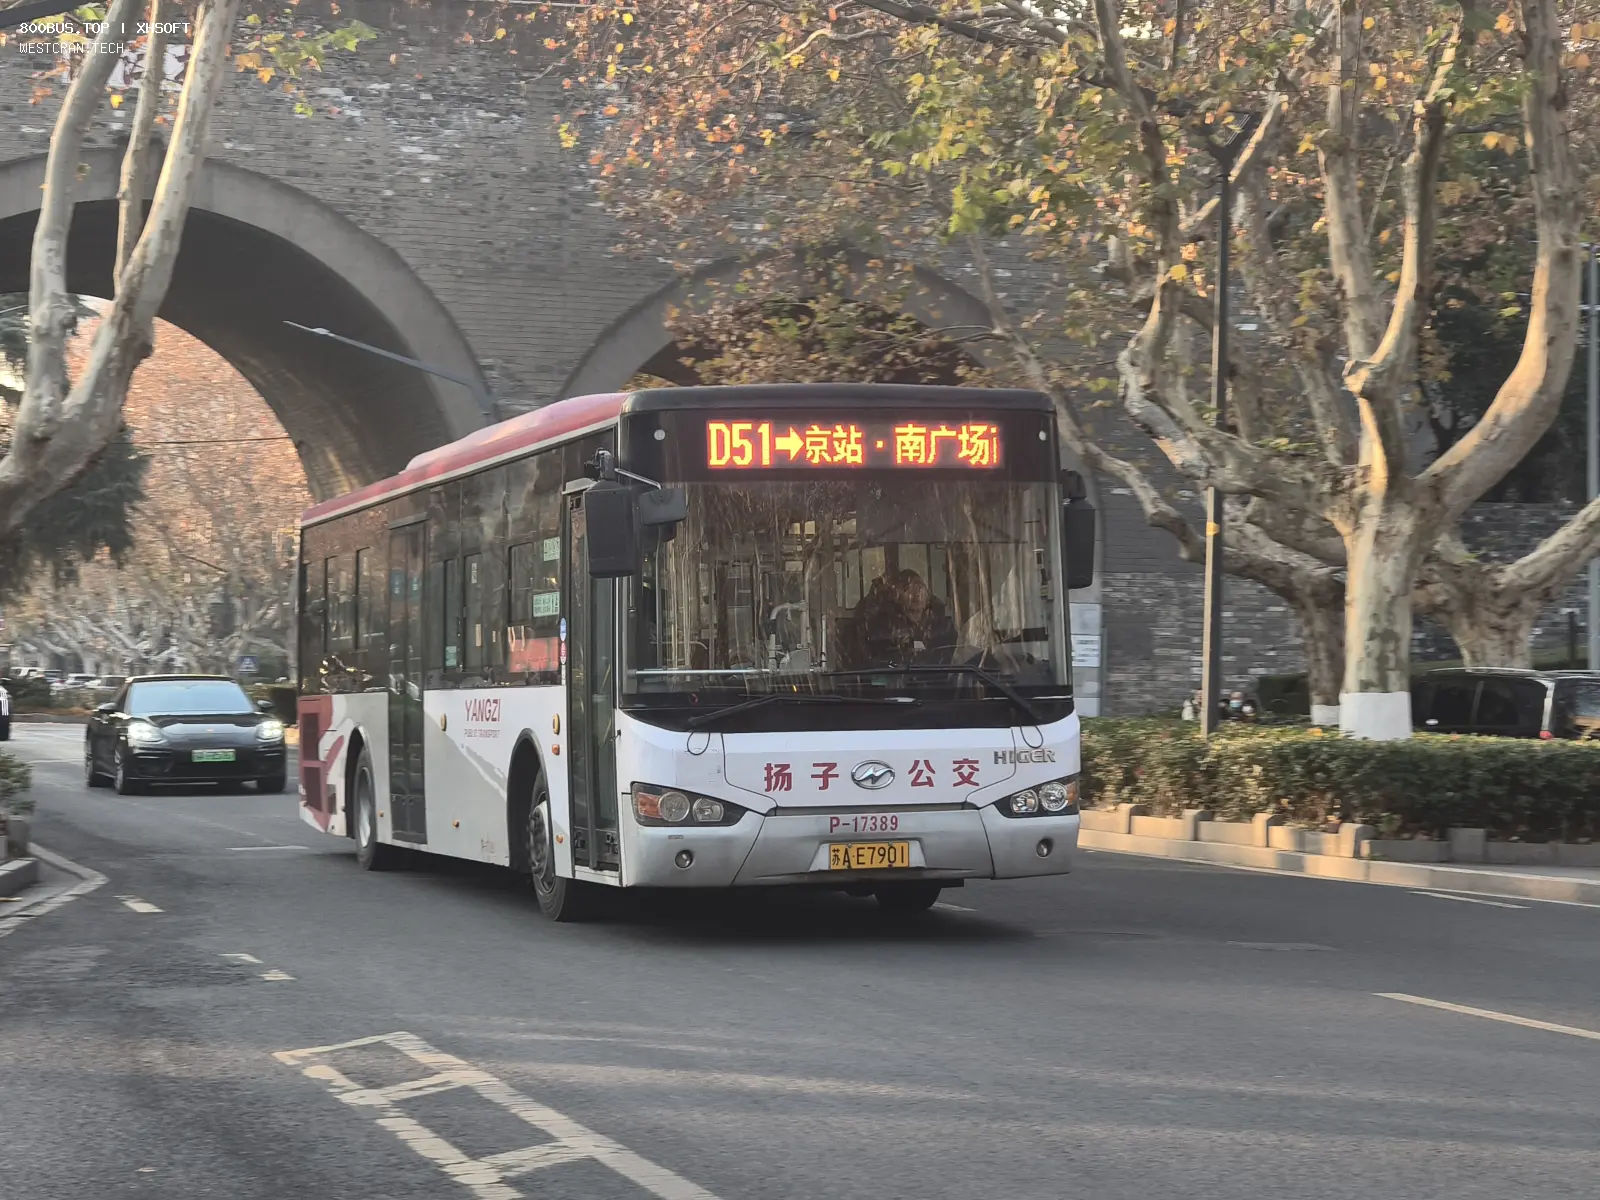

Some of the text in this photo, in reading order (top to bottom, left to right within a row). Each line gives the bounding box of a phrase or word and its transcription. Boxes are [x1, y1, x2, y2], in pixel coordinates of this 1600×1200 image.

[708, 423, 998, 466] D51 京站·南广场
[465, 698, 501, 722] YANGZI
[993, 749, 1056, 765] HIGER
[764, 758, 980, 792] 扬子 公交
[829, 815, 899, 834] P-17389
